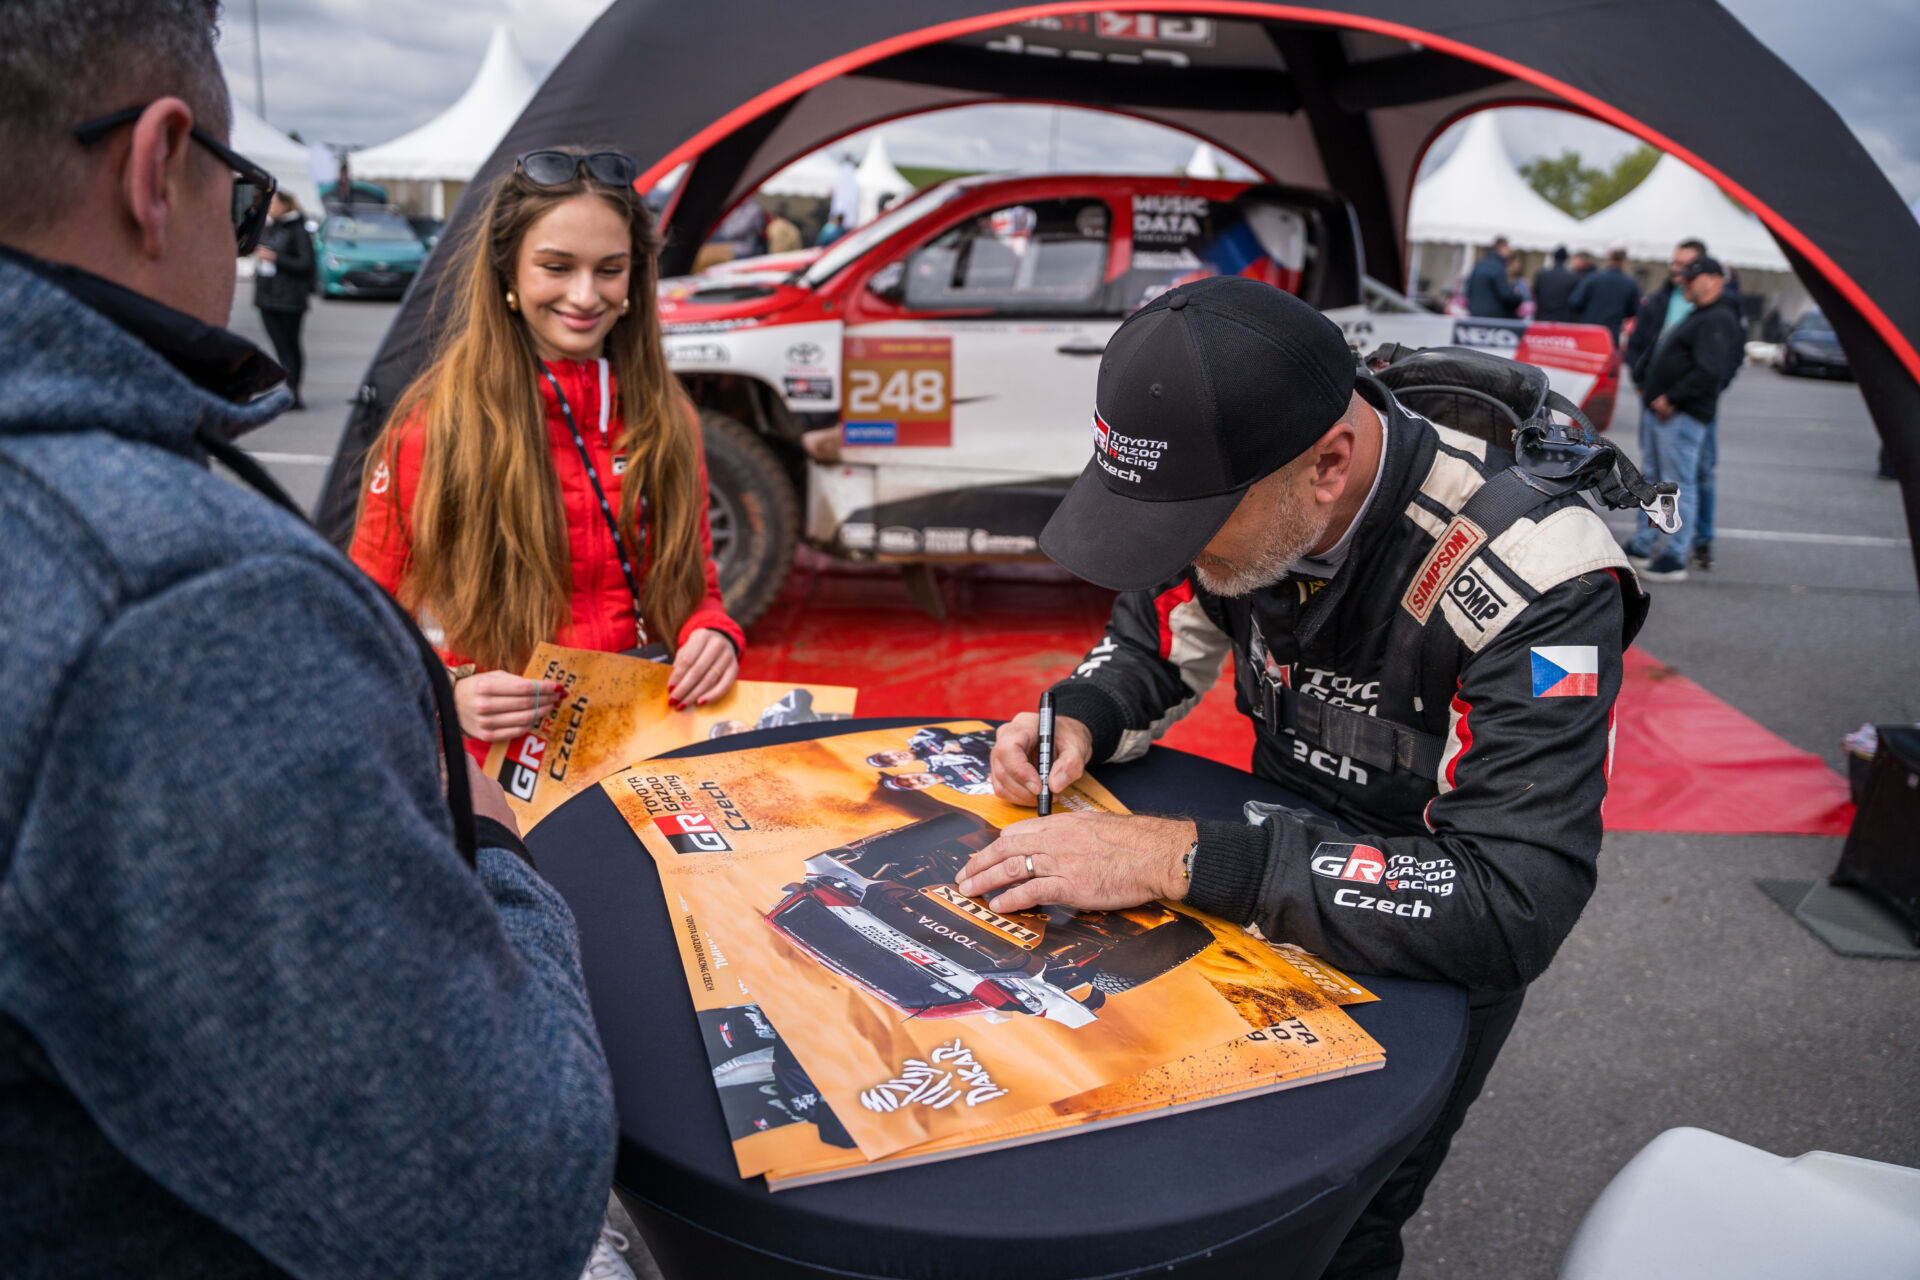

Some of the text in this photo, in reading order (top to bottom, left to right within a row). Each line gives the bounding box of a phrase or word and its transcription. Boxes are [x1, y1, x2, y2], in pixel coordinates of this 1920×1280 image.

[1132, 194, 1209, 217] MUSIC
[1133, 214, 1201, 236] DATA
[850, 369, 945, 414] 248
[1110, 430, 1168, 450] TOYOTA
[1110, 440, 1161, 459] GAZOO
[1096, 451, 1142, 483] Czech
[1108, 447, 1158, 471] Racing
[1412, 529, 1469, 611] SIMPSON
[1453, 574, 1500, 621] OMP
[550, 696, 588, 782] Czech
[511, 734, 546, 800] GR
[627, 776, 662, 816] TOYOTA
[646, 776, 681, 812] GAZOO
[664, 775, 700, 811] Racing
[698, 781, 752, 831] Czech
[675, 813, 727, 851] GR
[1311, 855, 1382, 881] GR
[1333, 888, 1432, 918] Czech
[1385, 879, 1454, 897] Racing
[935, 886, 1037, 942] HILUX
[918, 915, 978, 950] TOYOTA
[686, 914, 715, 992] TOYOTA GAZOO RACING CZECH
[931, 1037, 1009, 1107] DAKAR
